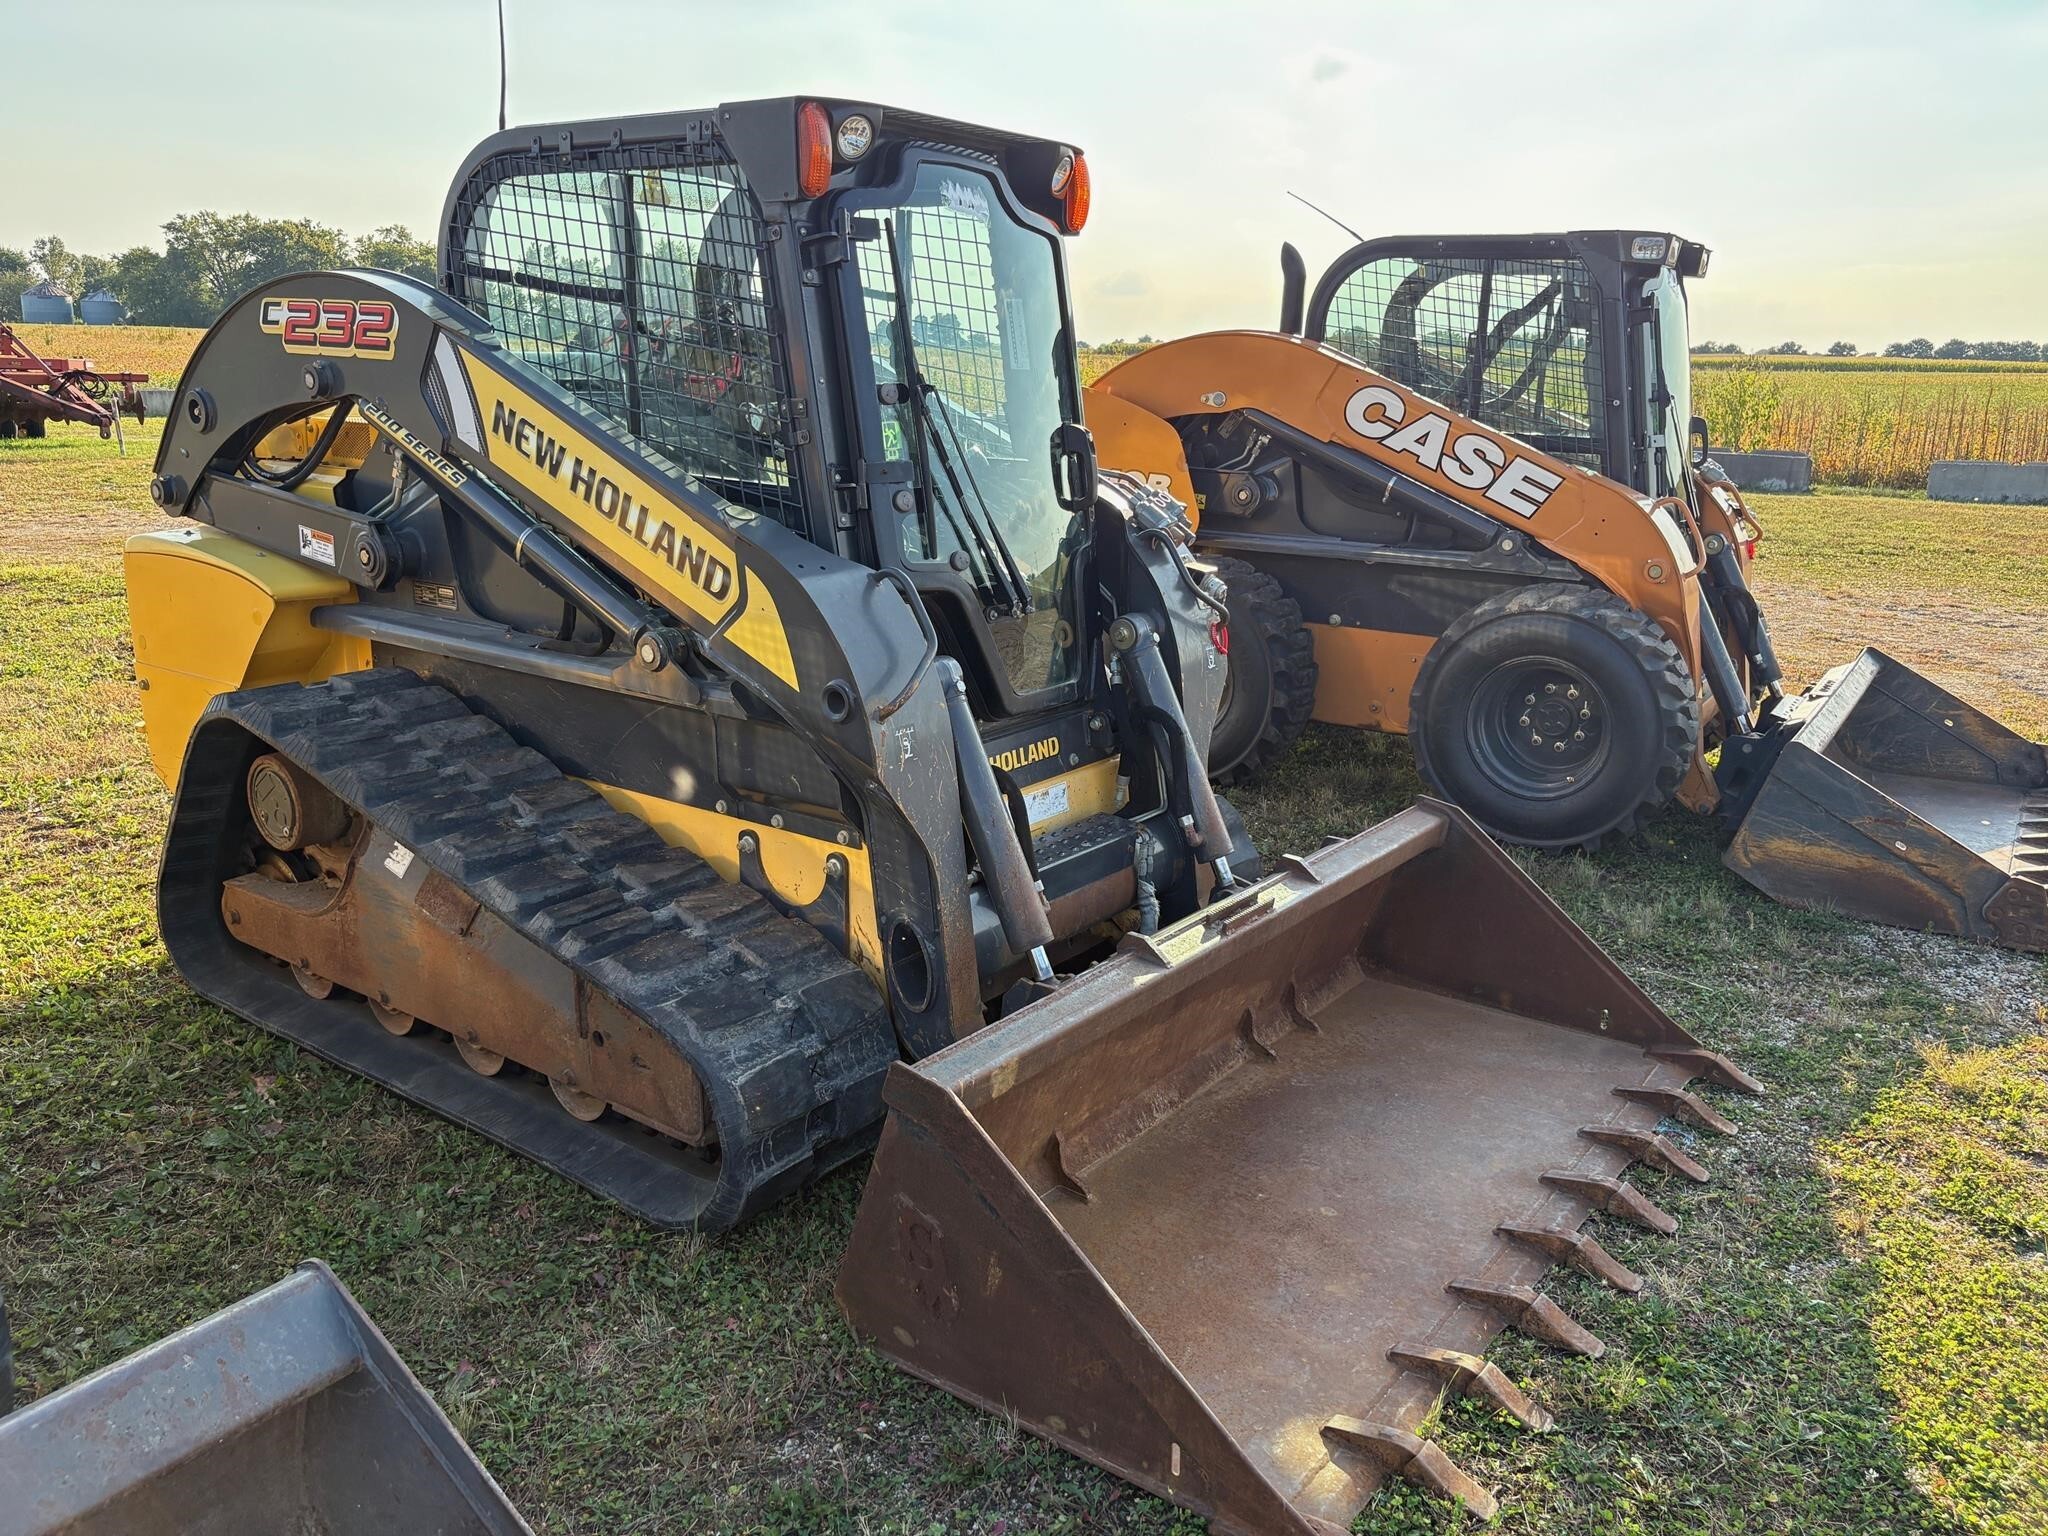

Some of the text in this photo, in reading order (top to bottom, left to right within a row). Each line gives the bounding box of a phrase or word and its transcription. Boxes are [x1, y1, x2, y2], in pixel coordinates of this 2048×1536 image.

[365, 402, 467, 485] 200 SERIES
[491, 398, 733, 603] NEW HOLLAND
[1344, 385, 1566, 520] CASE
